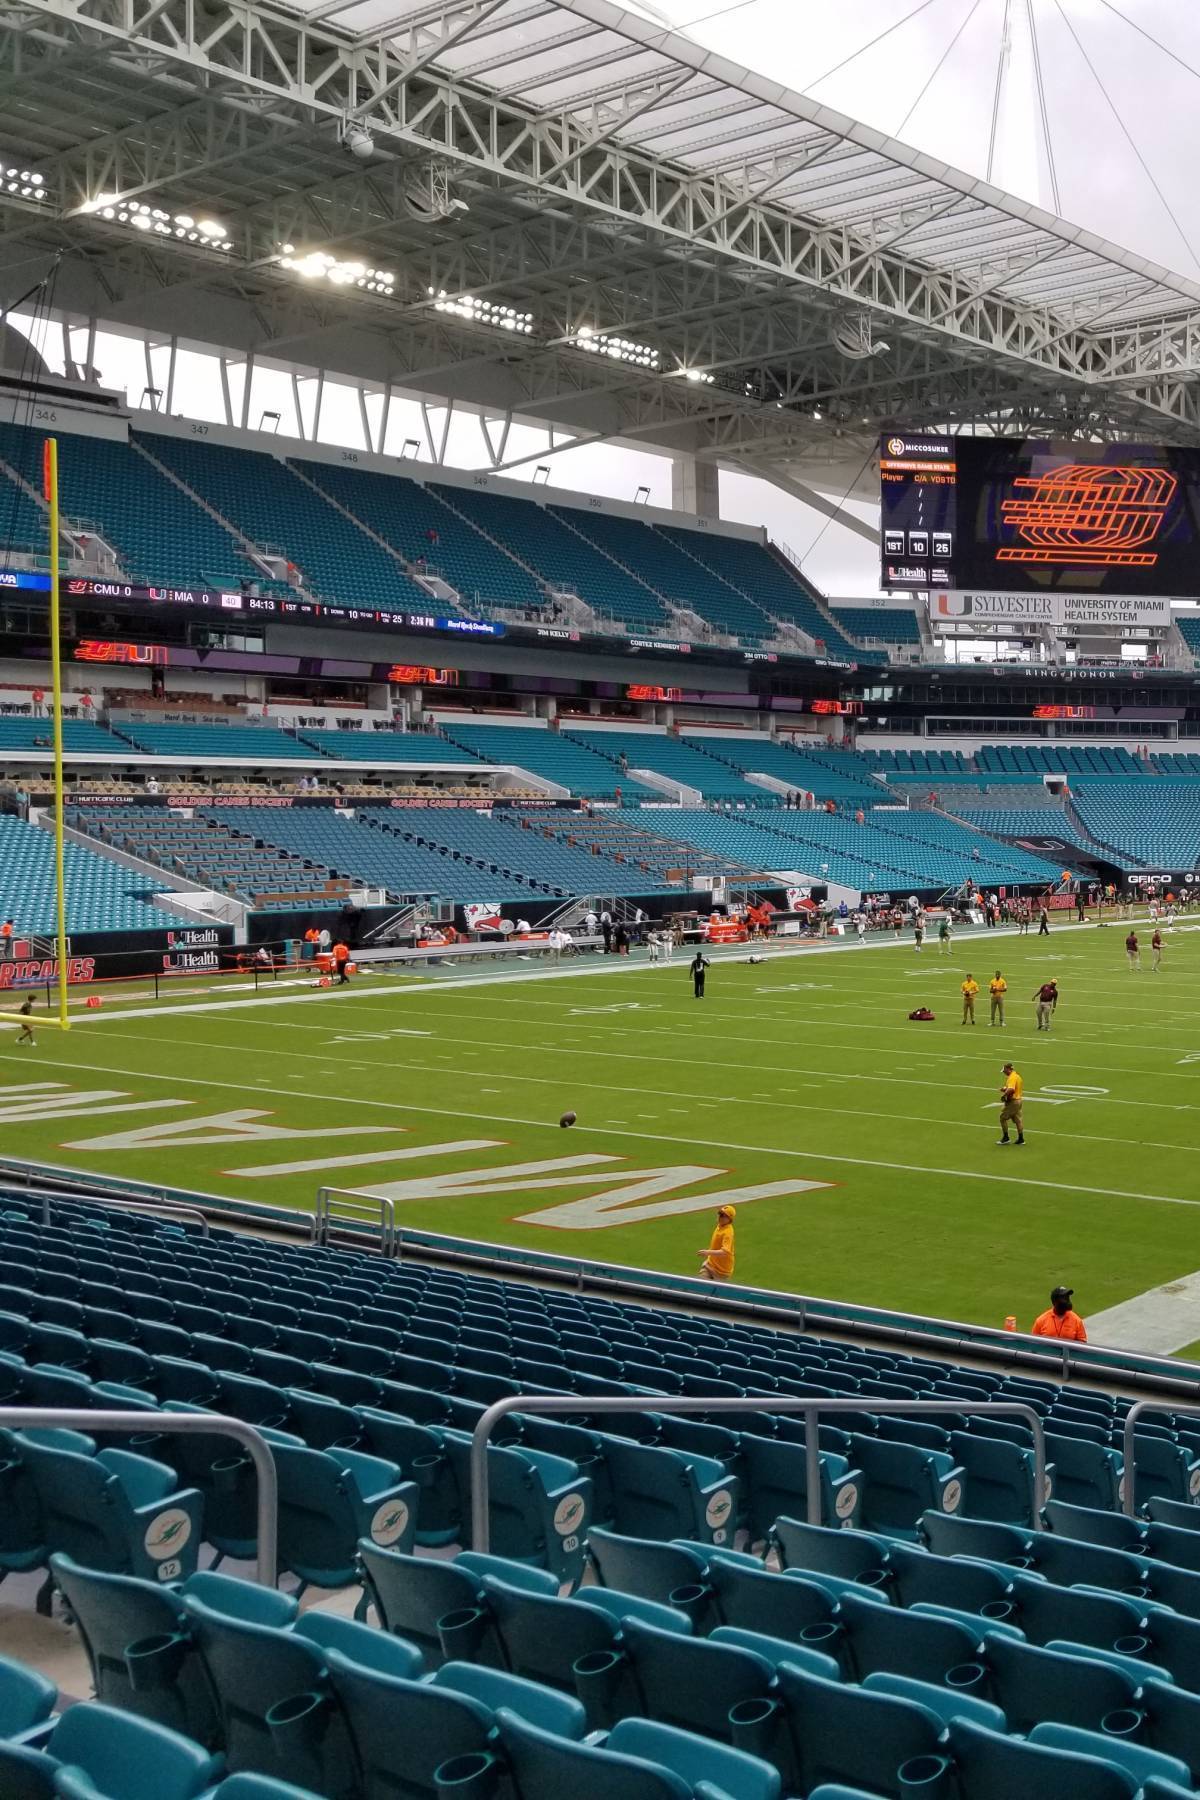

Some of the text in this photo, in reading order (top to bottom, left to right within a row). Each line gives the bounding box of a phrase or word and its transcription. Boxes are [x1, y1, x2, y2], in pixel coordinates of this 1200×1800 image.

[35, 409, 57, 422] 346
[191, 425, 209, 435] 347
[906, 444, 949, 453] MICCOSUKEE
[342, 452, 358, 463] 348
[881, 473, 904, 482] Player
[914, 475, 927, 484] C/A
[887, 541, 902, 551] 1ST
[913, 541, 924, 552] 10
[936, 543, 949, 553] 25
[93, 584, 132, 597] CMU 0
[174, 591, 194, 602] MIA
[202, 594, 209, 604] 0
[249, 600, 275, 610] 84:13
[285, 603, 297, 611] 1ST
[974, 595, 1052, 614] SYLVESTER
[1064, 599, 1164, 611] UNIVERSITY OF MIAMI
[348, 610, 358, 619] 10
[392, 614, 403, 623] 25
[1064, 611, 1138, 622] HEALTH SYSTEM
[550, 630, 569, 639] KELLY
[1026, 668, 1057, 678] RING
[1069, 669, 1116, 679] HONOR
[167, 797, 212, 806] GOLDEN
[214, 797, 250, 806] CANES
[1128, 874, 1172, 883] GEICO
[162, 951, 218, 969] UHealth
[981, 1084, 1111, 1109] 10
[163, 1562, 177, 1577] 12
